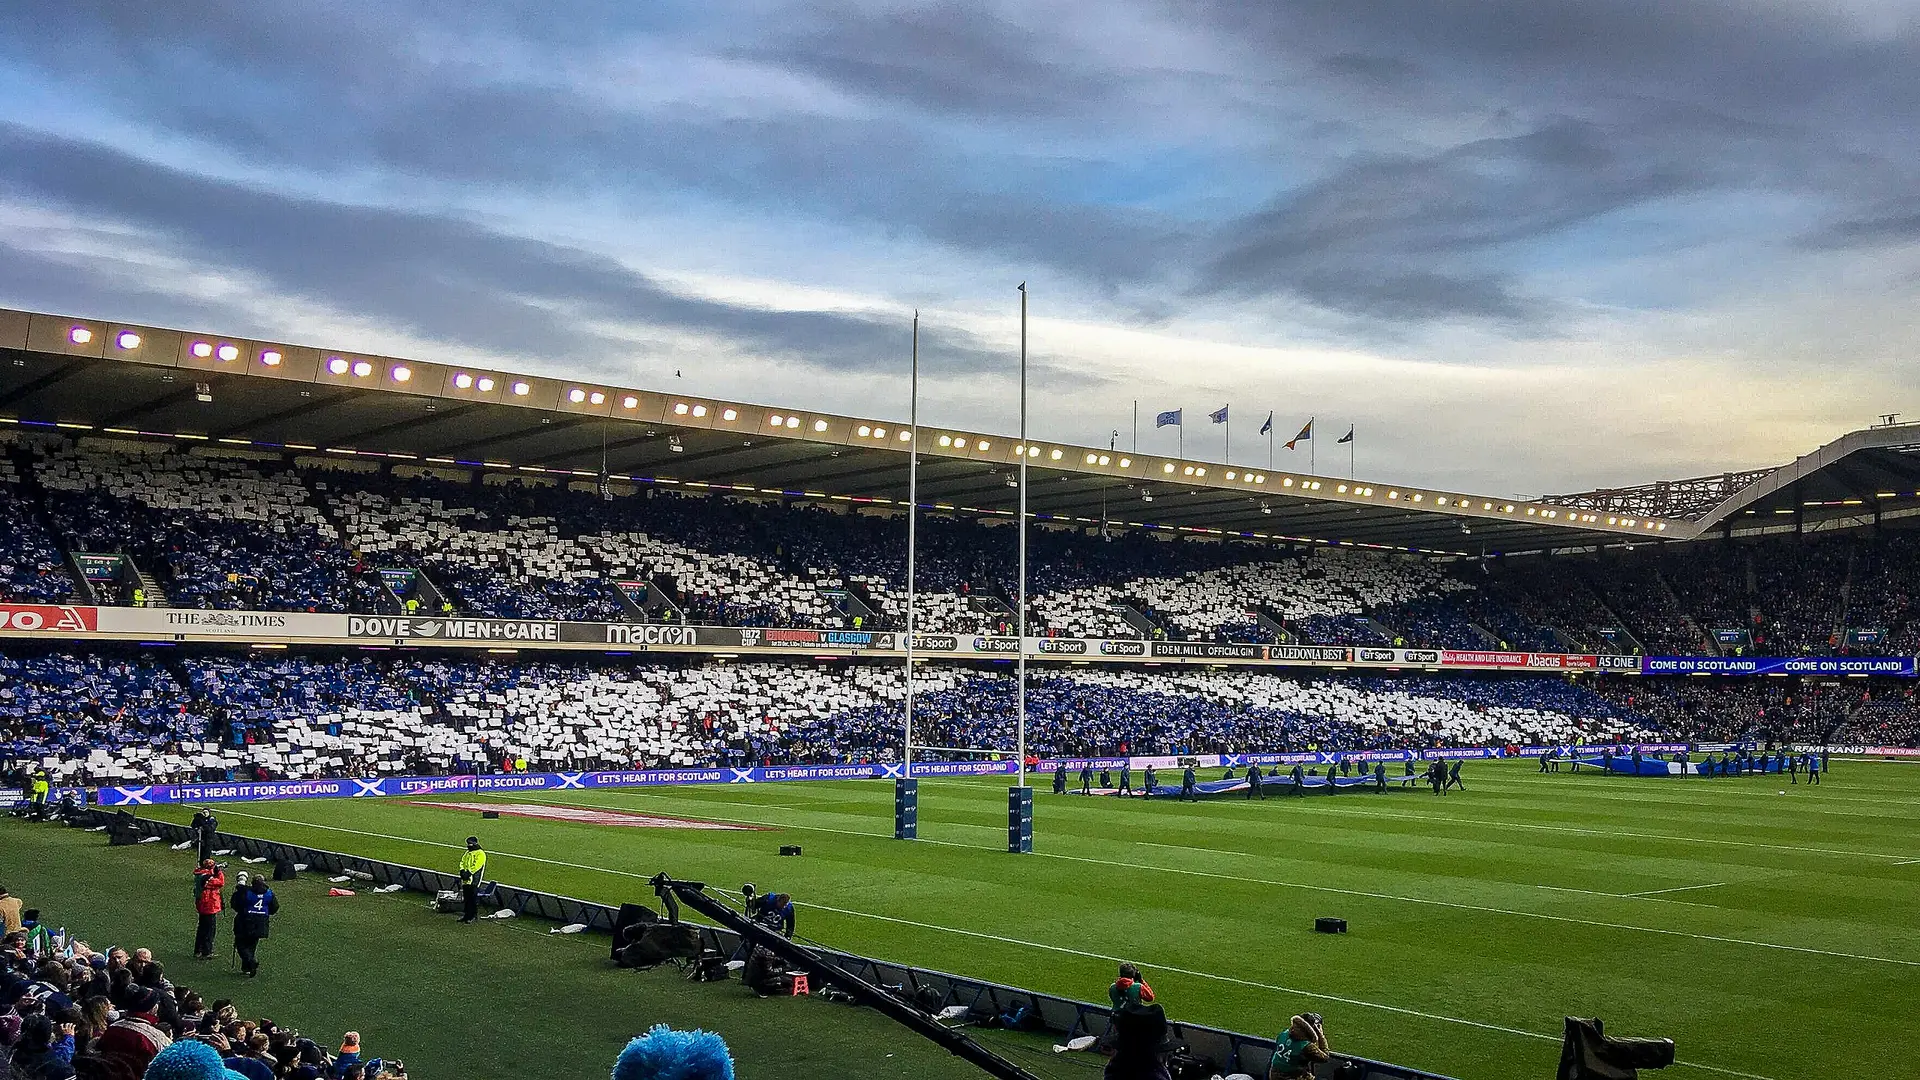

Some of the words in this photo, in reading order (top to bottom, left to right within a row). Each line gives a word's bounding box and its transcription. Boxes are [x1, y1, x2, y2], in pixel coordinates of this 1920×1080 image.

[166, 613, 200, 624] THE
[239, 615, 285, 627] TIMES
[350, 618, 410, 636] DOVE
[445, 621, 557, 640] MEN+CARE
[606, 625, 696, 645] macron
[741, 630, 761, 639] 1872
[741, 638, 757, 647] CUP
[828, 632, 872, 644] GLASGOW
[912, 639, 924, 647] BT
[926, 637, 953, 650] Sport
[979, 640, 995, 649] BT
[995, 639, 1019, 652] Sport
[1044, 643, 1058, 651] BT
[1059, 642, 1083, 654] Sport
[1106, 644, 1119, 653] BT
[1119, 643, 1141, 654] Sport
[1156, 645, 1203, 656] EDEN.MILL
[1208, 647, 1240, 656] OFFICIAL
[1241, 647, 1254, 657] GIN
[1271, 647, 1321, 660] CALEDONIA
[1322, 649, 1344, 660] BEST
[1374, 651, 1392, 660] Sport
[1417, 652, 1435, 662] Sport
[1456, 653, 1475, 662] HEALTH
[1475, 654, 1485, 662] AND
[1485, 654, 1496, 663] LIFE
[1496, 654, 1522, 663] INSURANCE
[1526, 653, 1560, 667] Abacus
[1599, 658, 1611, 667] AS
[1613, 657, 1634, 667] ONE
[1650, 660, 1677, 670] COME
[1679, 661, 1695, 670] ON
[1696, 661, 1755, 670] SCOTLAND!
[1785, 661, 1817, 671] COME
[1820, 661, 1836, 671] ON
[1840, 661, 1902, 671] SCOTLAND!
[912, 765, 930, 773] LET'S
[931, 765, 949, 773] HEAR
[950, 764, 958, 772] IT
[958, 764, 972, 772] FOR
[973, 763, 1007, 772] SCOTLAND
[1040, 762, 1057, 770] LET'S
[1058, 762, 1075, 770] HAR
[1075, 761, 1082, 769] IT
[1094, 761, 1125, 769] SCOTLAND
[597, 775, 621, 784] LET'S
[622, 774, 647, 783] HEAR
[648, 773, 657, 782] IT
[658, 773, 676, 782] FOR
[677, 771, 721, 781] SCOTLAND
[765, 770, 786, 779] LET'S
[787, 769, 808, 778] HEAR
[809, 769, 817, 777] IT
[818, 768, 834, 777] FOR
[835, 767, 873, 776] SCOTLAND
[401, 781, 428, 791] LET'S
[430, 779, 459, 790] HEAR
[460, 779, 470, 788] IT
[472, 778, 491, 788] FOR
[494, 777, 545, 788] SCOTLAND
[170, 788, 201, 799] LET'S
[204, 786, 237, 798] HEAR
[239, 786, 251, 796] IT
[253, 785, 277, 796] FOR
[279, 784, 339, 795] SCOTLAND
[254, 899, 263, 911] 4
[1277, 1044, 1292, 1063] 24
